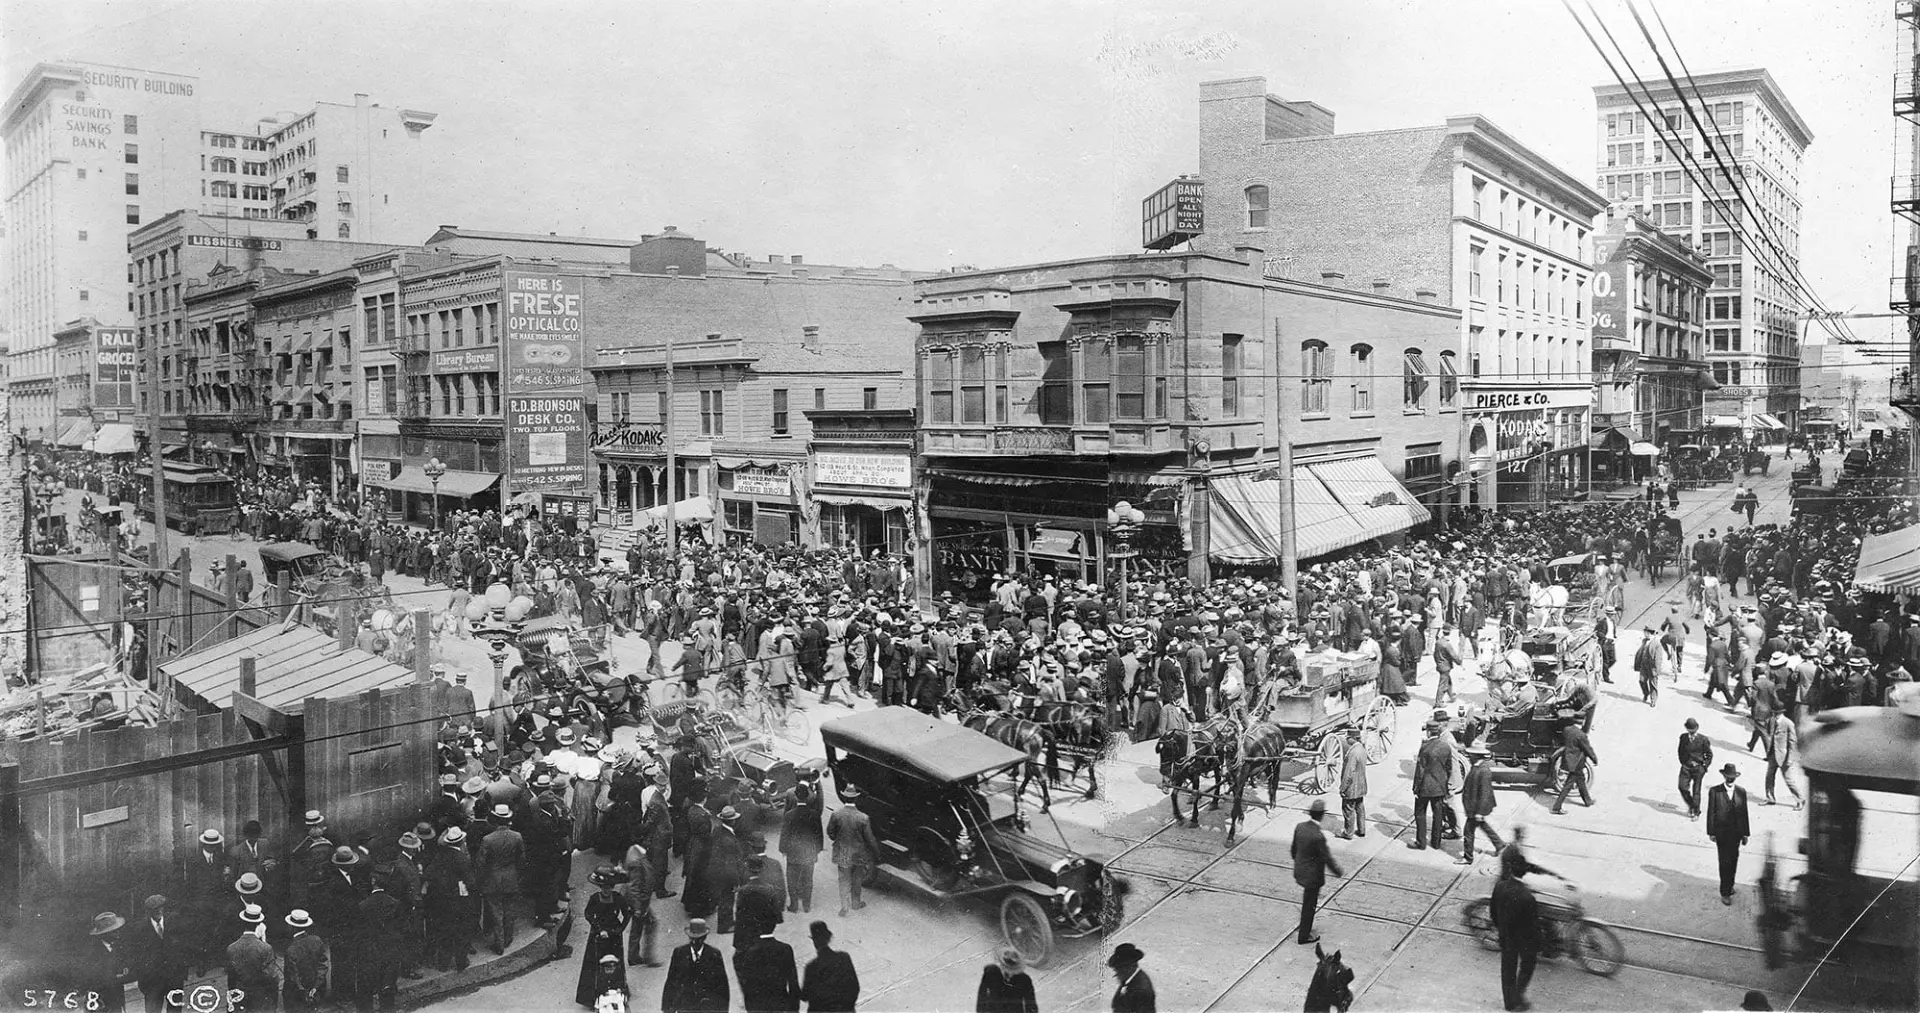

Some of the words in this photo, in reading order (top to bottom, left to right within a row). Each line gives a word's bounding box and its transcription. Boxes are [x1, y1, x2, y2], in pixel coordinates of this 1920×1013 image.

[83, 71, 139, 90] SECURITY
[144, 78, 193, 97] BUILDING
[62, 104, 112, 119] SECURITY
[66, 120, 112, 135] SAVINGS
[72, 136, 107, 150] BANK
[1177, 184, 1203, 196] BANK
[1178, 196, 1202, 204] OPEN
[1178, 221, 1201, 229] DAY
[193, 236, 243, 248] LISSNER
[517, 278, 548, 291] HERE
[551, 279, 563, 292] IS
[509, 292, 580, 317] FRESE
[510, 316, 561, 331] OPTICAL
[562, 317, 581, 332] CO.
[435, 354, 464, 366] Library
[465, 352, 495, 364] Bureau
[524, 375, 543, 385] 546
[1476, 393, 1520, 409] PIERCE
[1523, 395, 1532, 405] &
[518, 413, 551, 425] DESK
[555, 413, 576, 424] CO.
[1500, 417, 1549, 438] KODAKS
[621, 429, 665, 446] KODAKS
[1507, 460, 1528, 473] 127
[526, 475, 546, 485] 542
[823, 475, 856, 483] HOWE
[738, 485, 761, 493] HOWE
